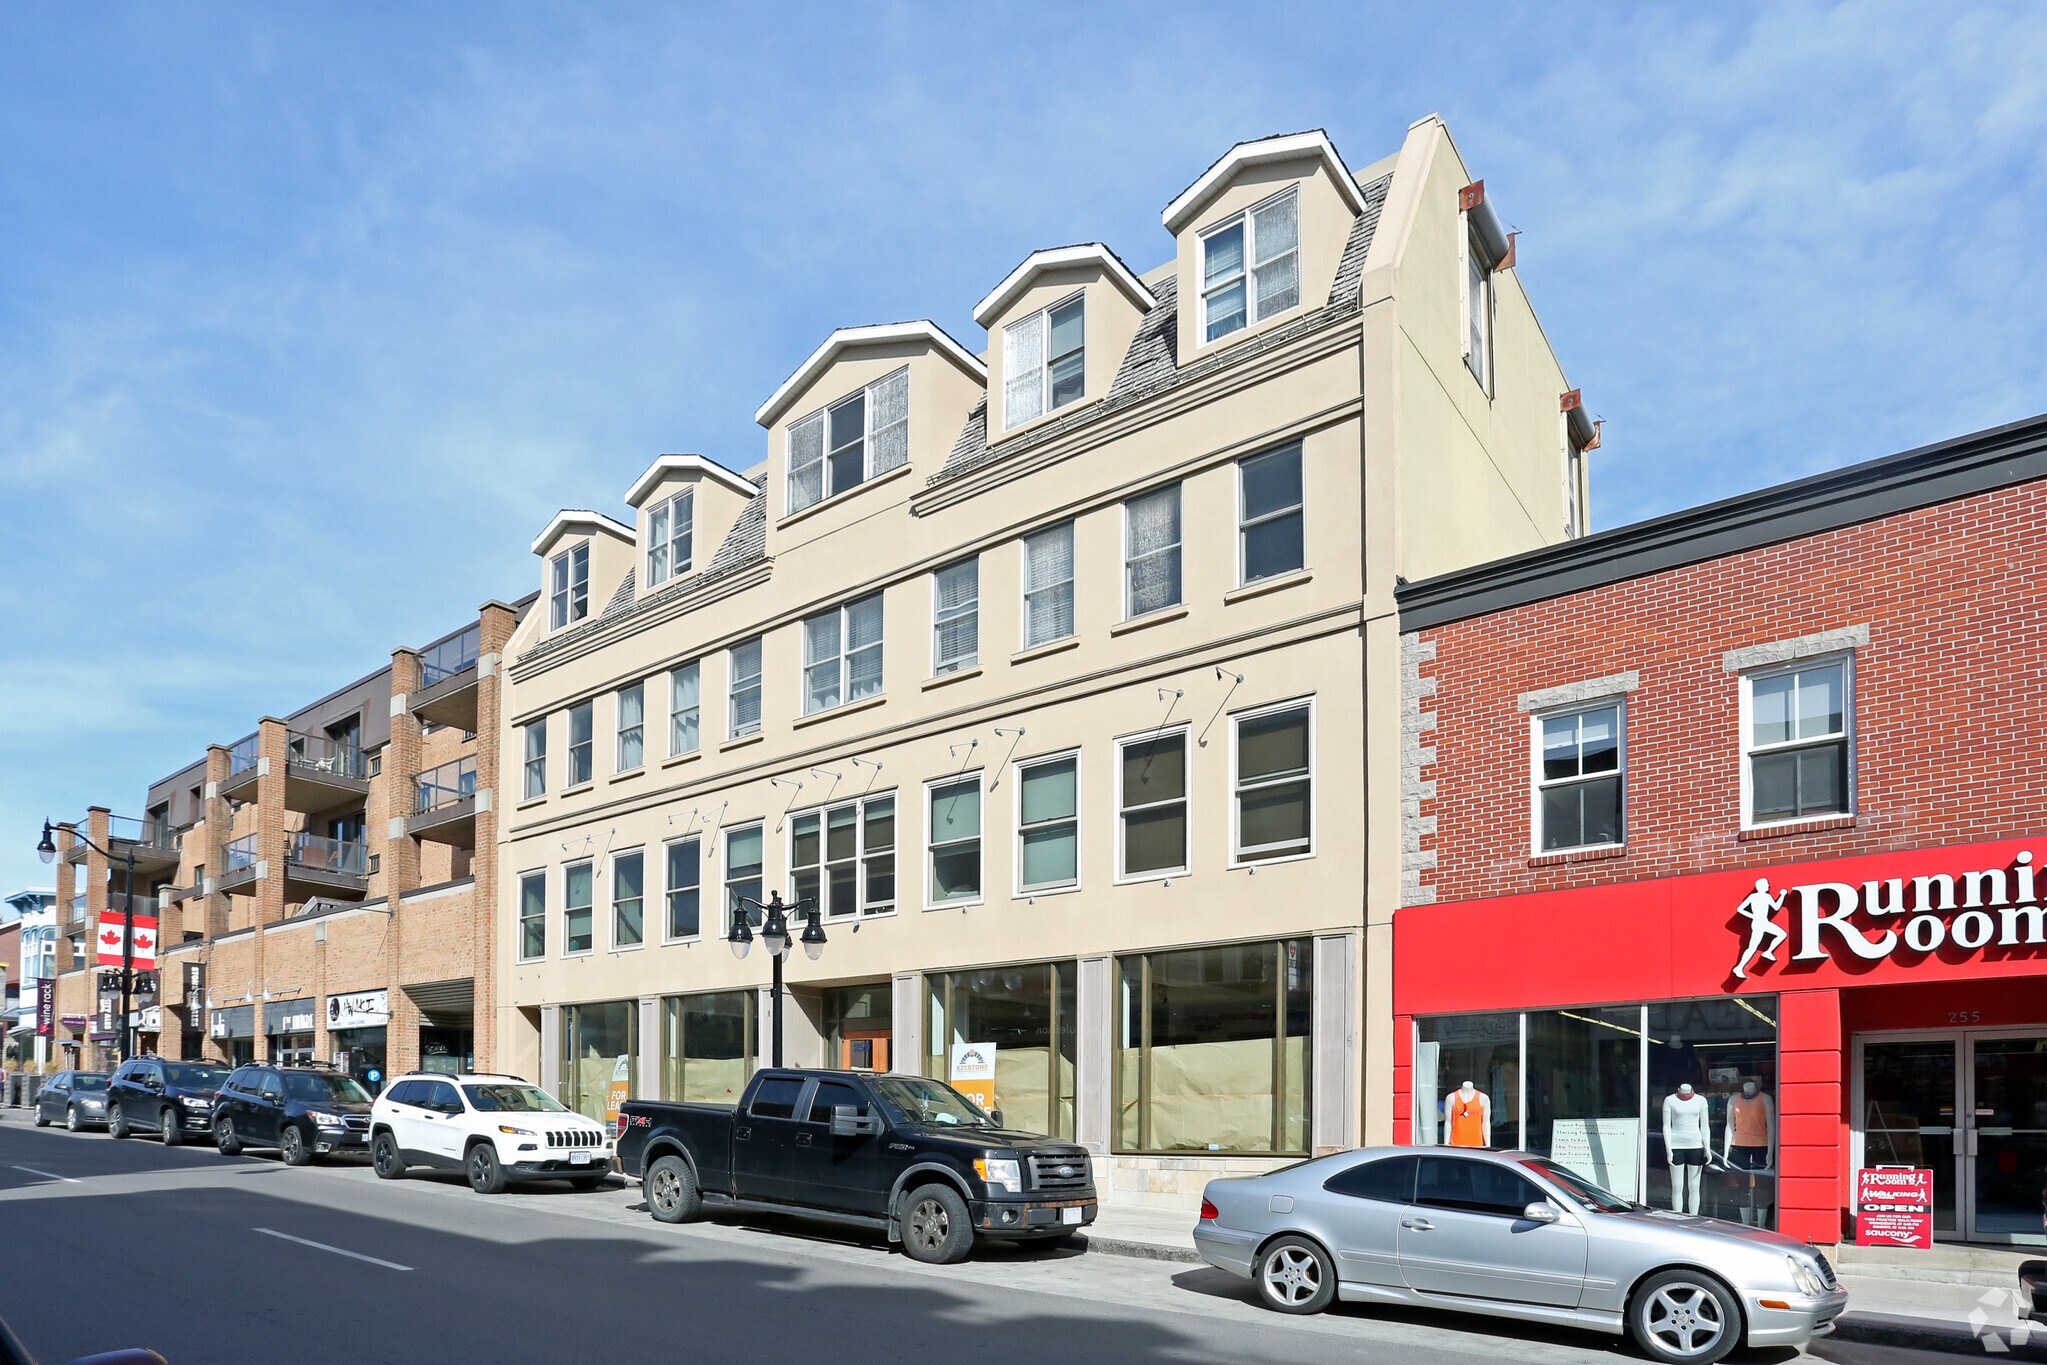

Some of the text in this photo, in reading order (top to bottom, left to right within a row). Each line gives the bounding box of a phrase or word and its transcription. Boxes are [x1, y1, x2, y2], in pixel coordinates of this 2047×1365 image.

[41, 983, 52, 1025] wine rack
[104, 1013, 112, 1030] ALES
[1948, 1011, 1981, 1023] 255
[956, 1064, 989, 1072] KEYSTONE
[611, 1090, 627, 1100] FOR
[965, 1092, 985, 1105] OR
[606, 1101, 626, 1110] LEA
[1869, 1172, 1916, 1185] Running
[1868, 1190, 1918, 1198] WALKING
[1863, 1204, 1924, 1212] OPEN
[1865, 1229, 1911, 1238] saucony
